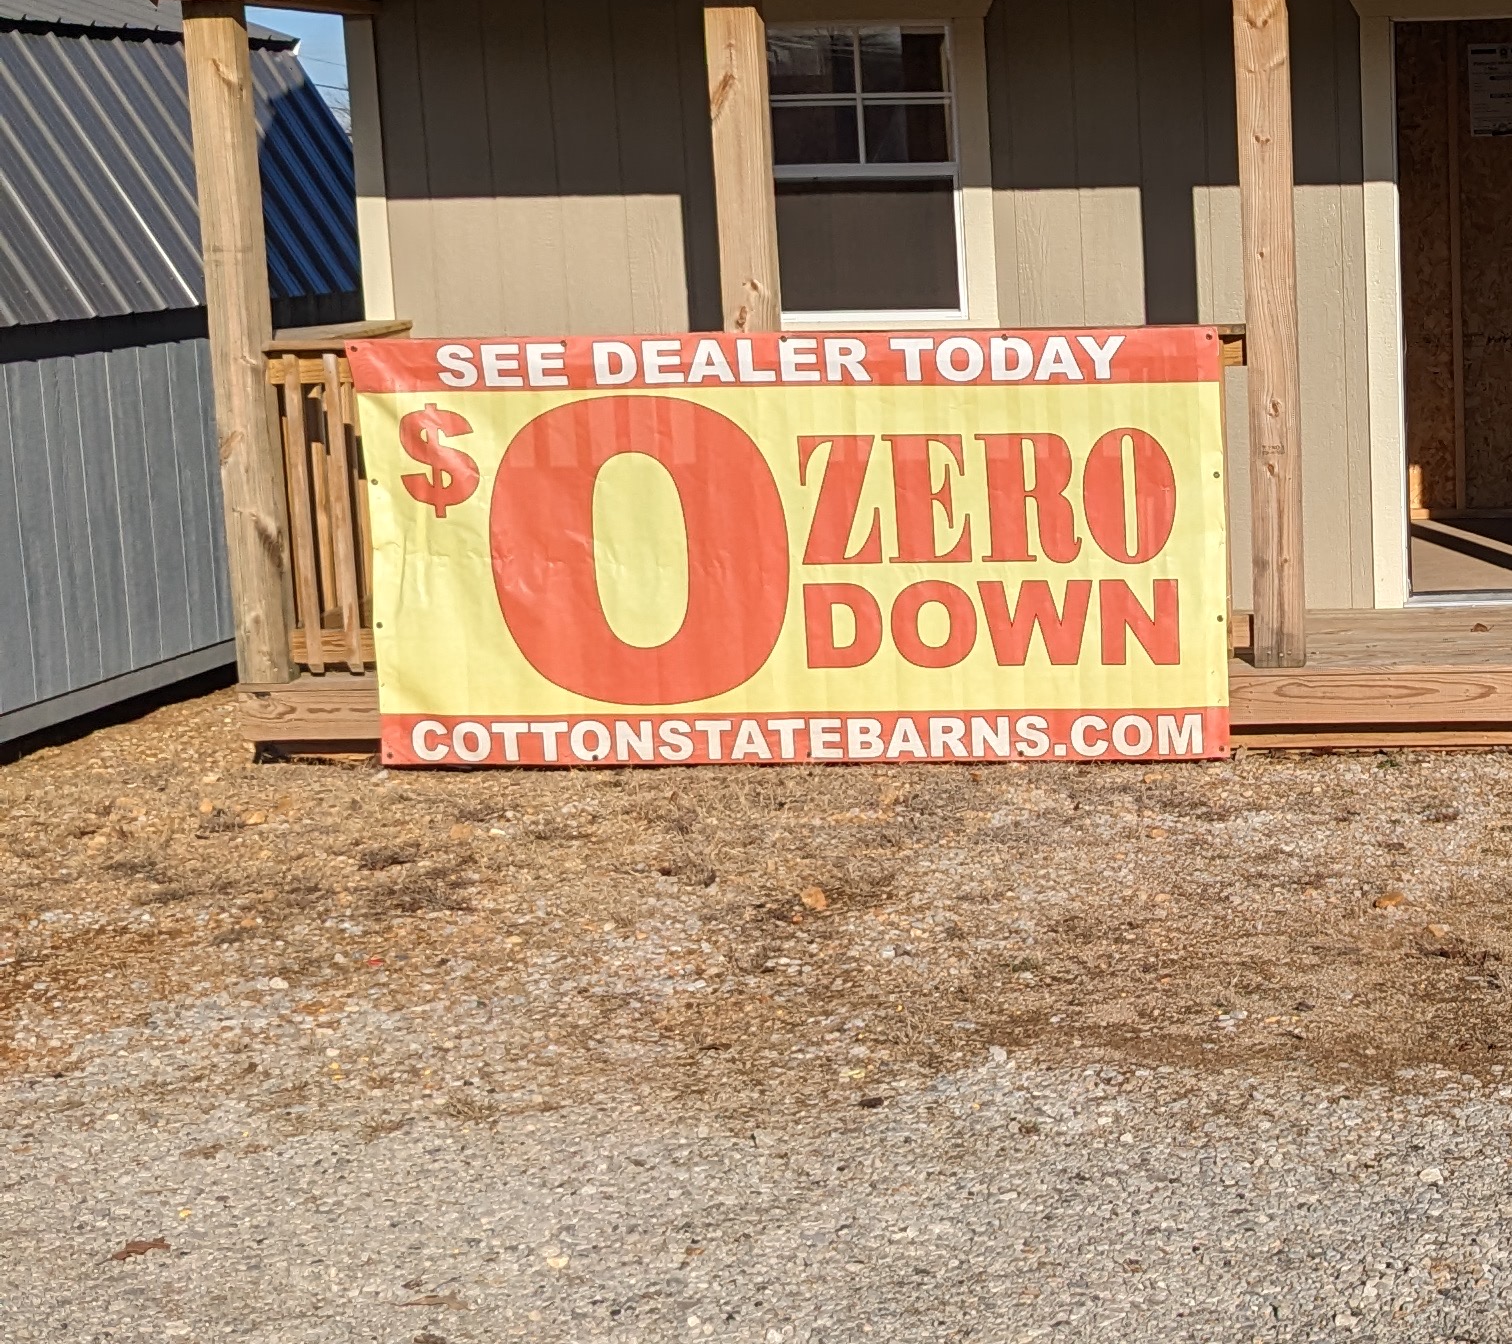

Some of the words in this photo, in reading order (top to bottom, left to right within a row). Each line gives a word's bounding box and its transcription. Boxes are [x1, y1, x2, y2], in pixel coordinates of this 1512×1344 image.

[436, 343, 566, 389] SEE
[591, 338, 871, 386] DEALER
[888, 334, 1126, 382] TODAY
[797, 427, 1178, 565] ZERO
[804, 578, 1181, 670] DOWN
[410, 713, 1203, 762] COTTONSTATEBARNS.COM
